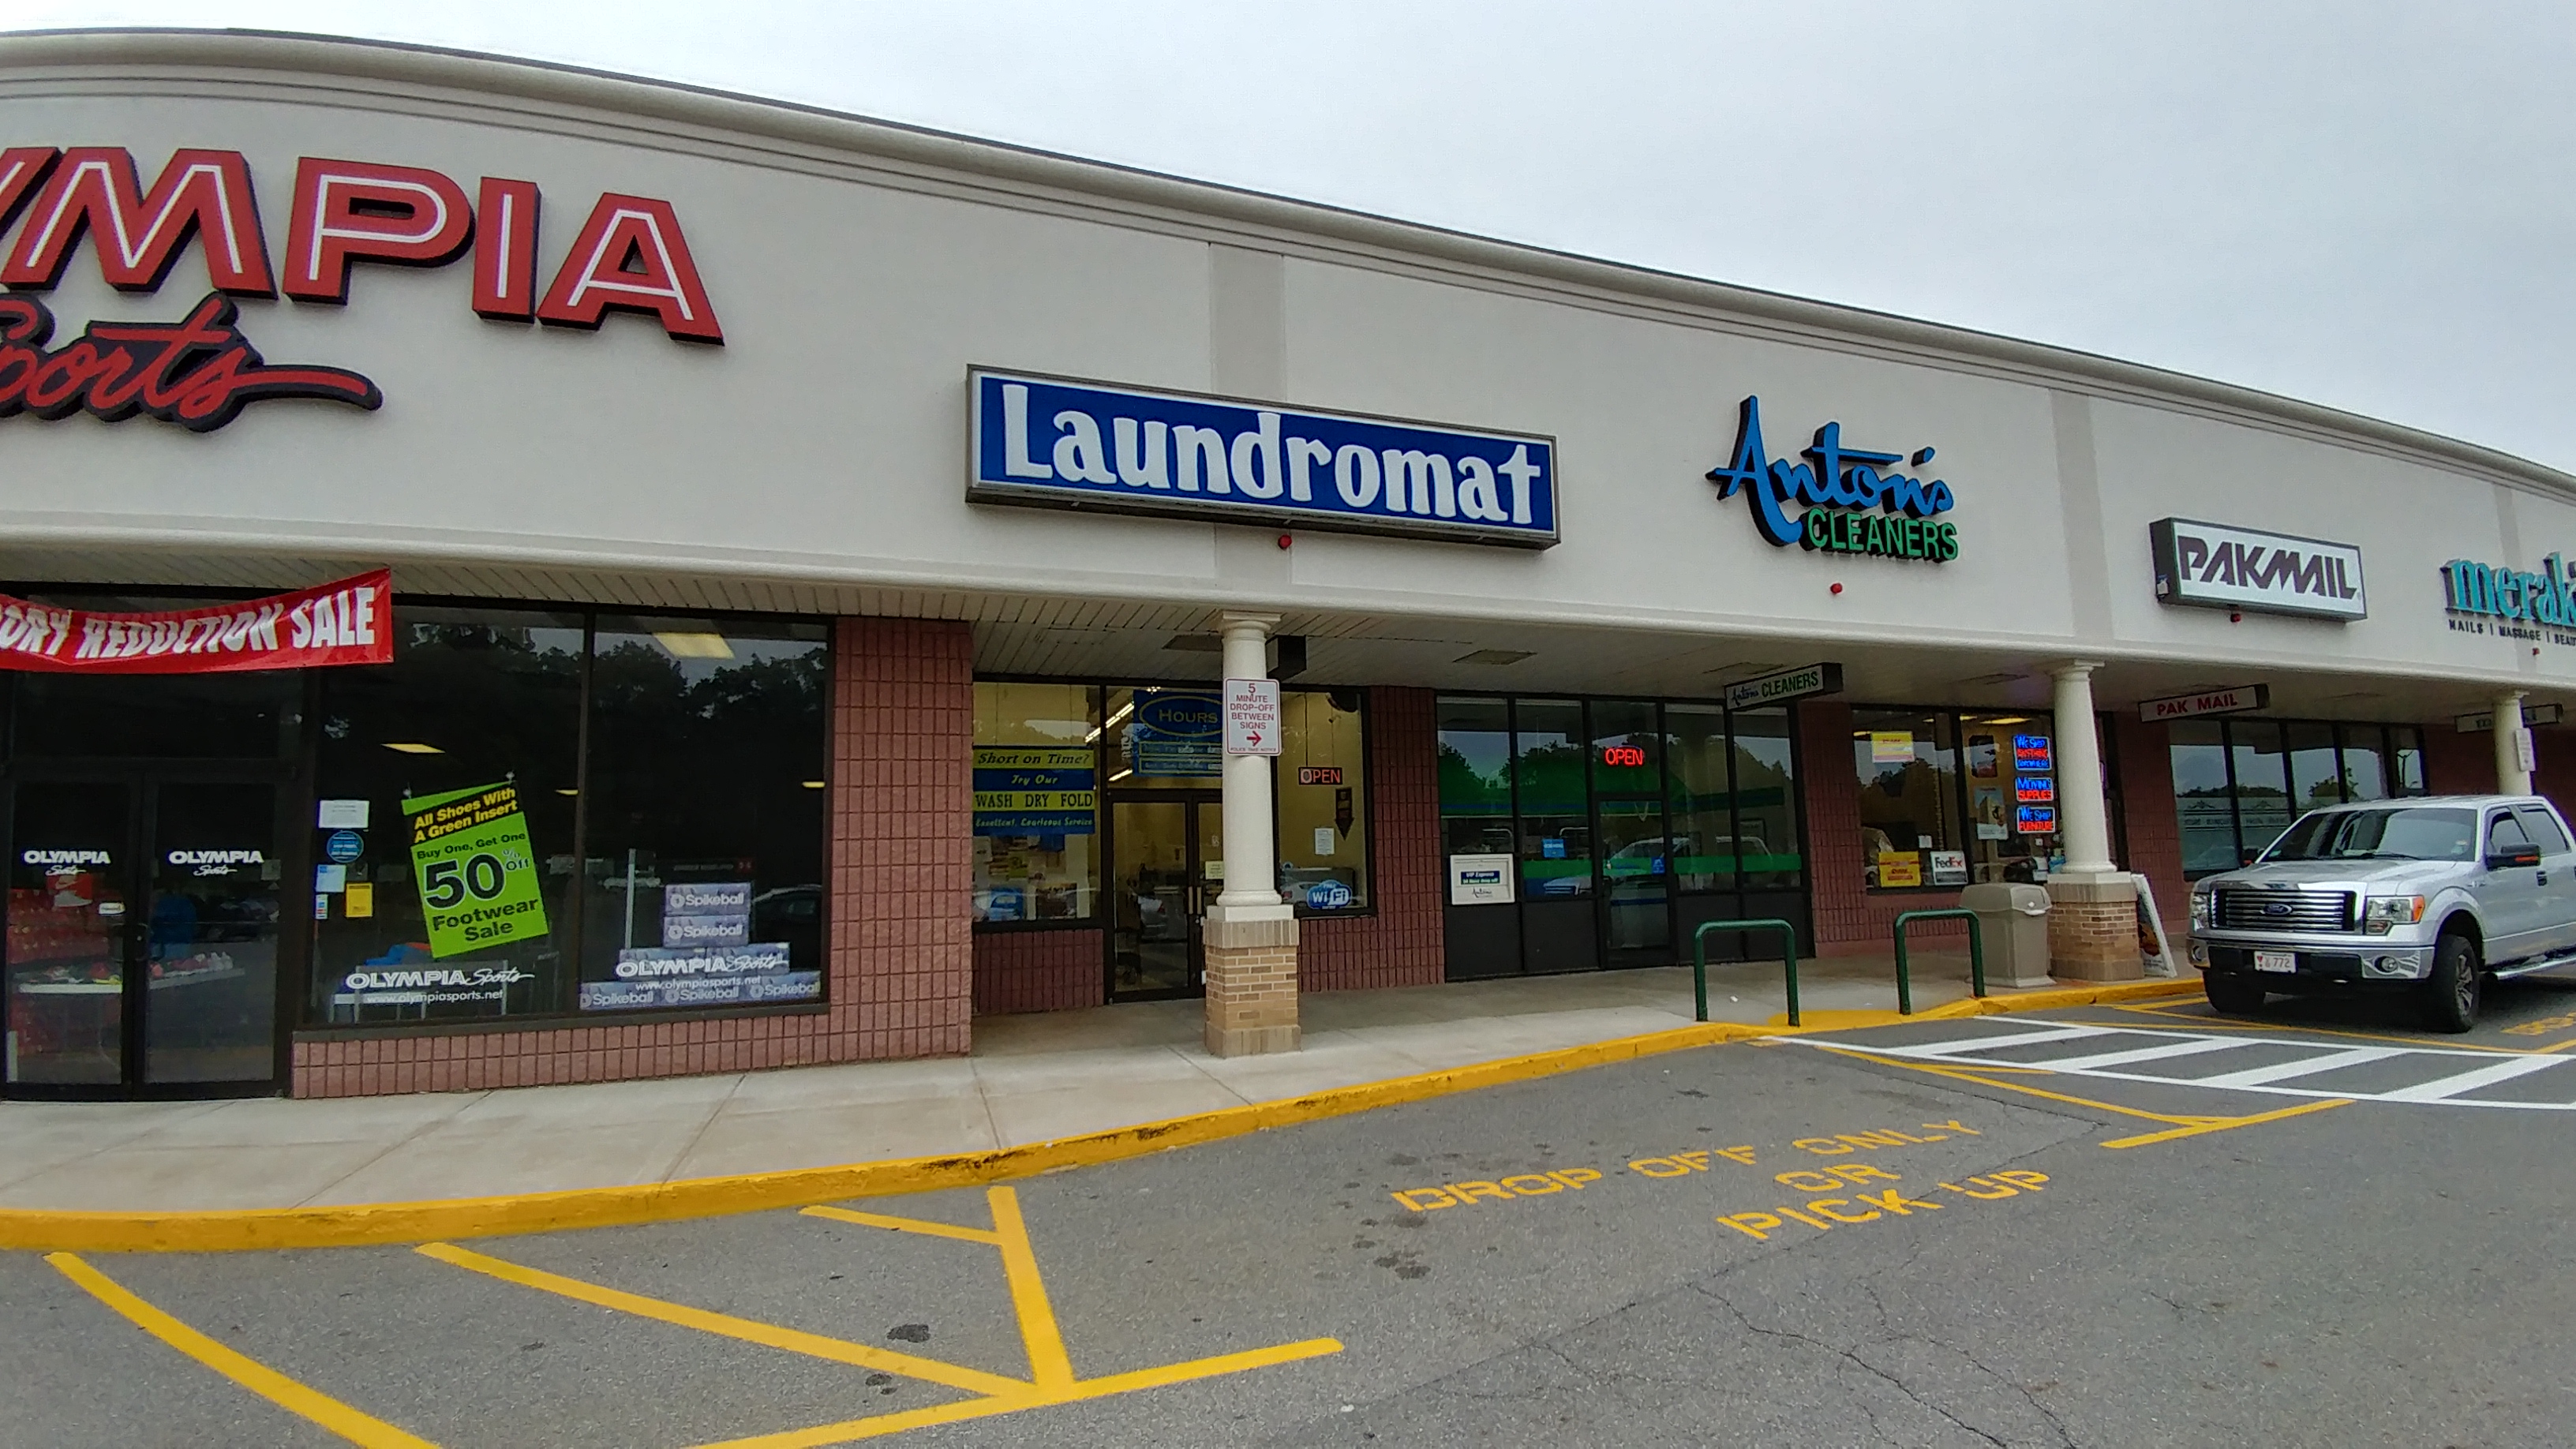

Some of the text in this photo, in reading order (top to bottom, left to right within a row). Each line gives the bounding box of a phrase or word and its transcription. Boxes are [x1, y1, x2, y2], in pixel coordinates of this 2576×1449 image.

[1002, 384, 1541, 525] Laundromat
[1804, 507, 1958, 563] CLEANERS
[2445, 552, 2576, 627] merak
[0, 587, 375, 658] ORY REDUCTION SALE
[2448, 620, 2484, 635] NAILS
[2499, 626, 2541, 641] MASSAGE
[1248, 683, 1256, 694] 5
[1761, 671, 1819, 698] CLEANERS
[2156, 694, 2237, 716] PAK MAIL
[978, 752, 1090, 764] Short on Time?
[1605, 748, 1643, 766] OPEN
[1011, 774, 1058, 785] Try Our
[1300, 769, 1341, 784] OPEN
[414, 787, 516, 830] All Shoes With
[975, 793, 1093, 807] WASH DRY FOLD
[414, 799, 518, 844] A Green Insert
[1064, 817, 1092, 826] Service
[417, 833, 526, 860] Buy One, Get One
[24, 850, 110, 864] OLYMPIA
[168, 850, 264, 864] OLYMPIA
[505, 857, 530, 871] Off
[1934, 856, 1963, 869] FedEx
[45, 865, 86, 876] Sports
[193, 865, 238, 876] Sports
[425, 852, 507, 911] 50
[685, 892, 744, 906] Spikeball
[432, 898, 539, 931] Footwear
[464, 921, 514, 942] Sale
[683, 923, 743, 938] Spikeball
[616, 953, 789, 978] OLYMPIA Sports
[2273, 957, 2290, 968] 772
[346, 966, 536, 990] OLYMPIA Sports
[635, 975, 762, 991] www.olympiasports.net
[366, 990, 504, 1005] www.olympiasports.net
[593, 991, 653, 1006] Spikeball
[680, 988, 739, 1002] Spikeball
[1390, 1119, 1982, 1212] DROP OFF ONLY
[1774, 1163, 1902, 1192] OR
[1716, 1170, 2050, 1240] PICK UP
